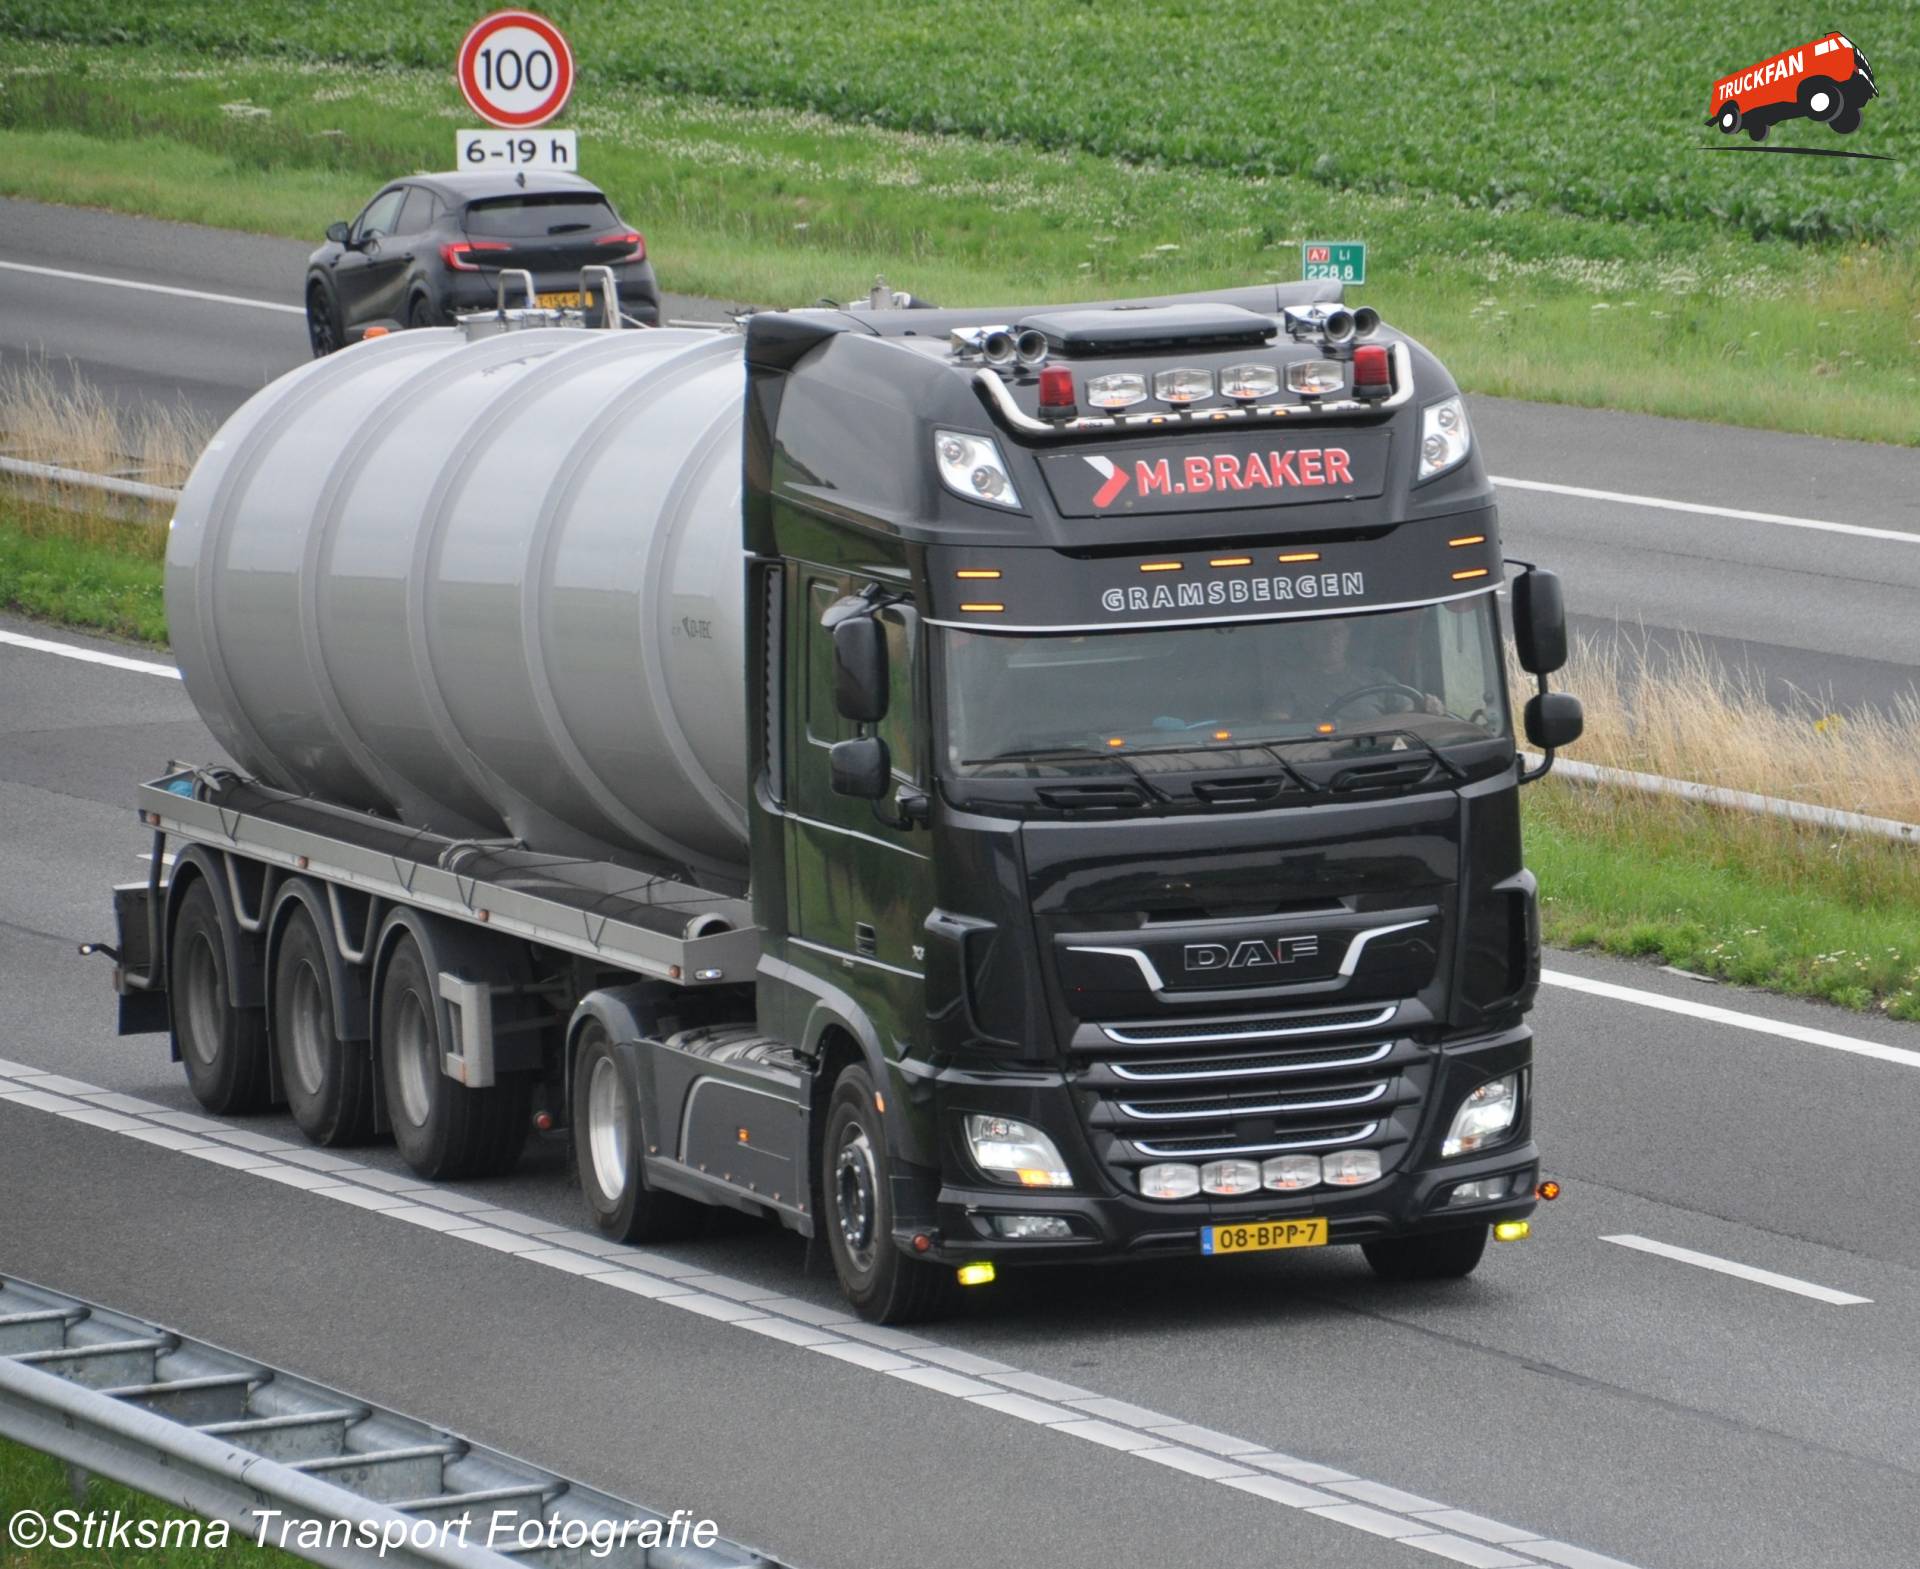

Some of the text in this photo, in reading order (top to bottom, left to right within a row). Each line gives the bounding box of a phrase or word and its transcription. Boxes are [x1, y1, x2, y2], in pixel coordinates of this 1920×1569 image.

[481, 49, 552, 91] 100
[466, 138, 567, 163] 6-19 h
[1136, 448, 1354, 496] M.BRAKER
[1102, 572, 1365, 612] GRAMSBERGEN
[1184, 935, 1318, 971] DAF
[1220, 1223, 1318, 1249] 08-BPP-7
